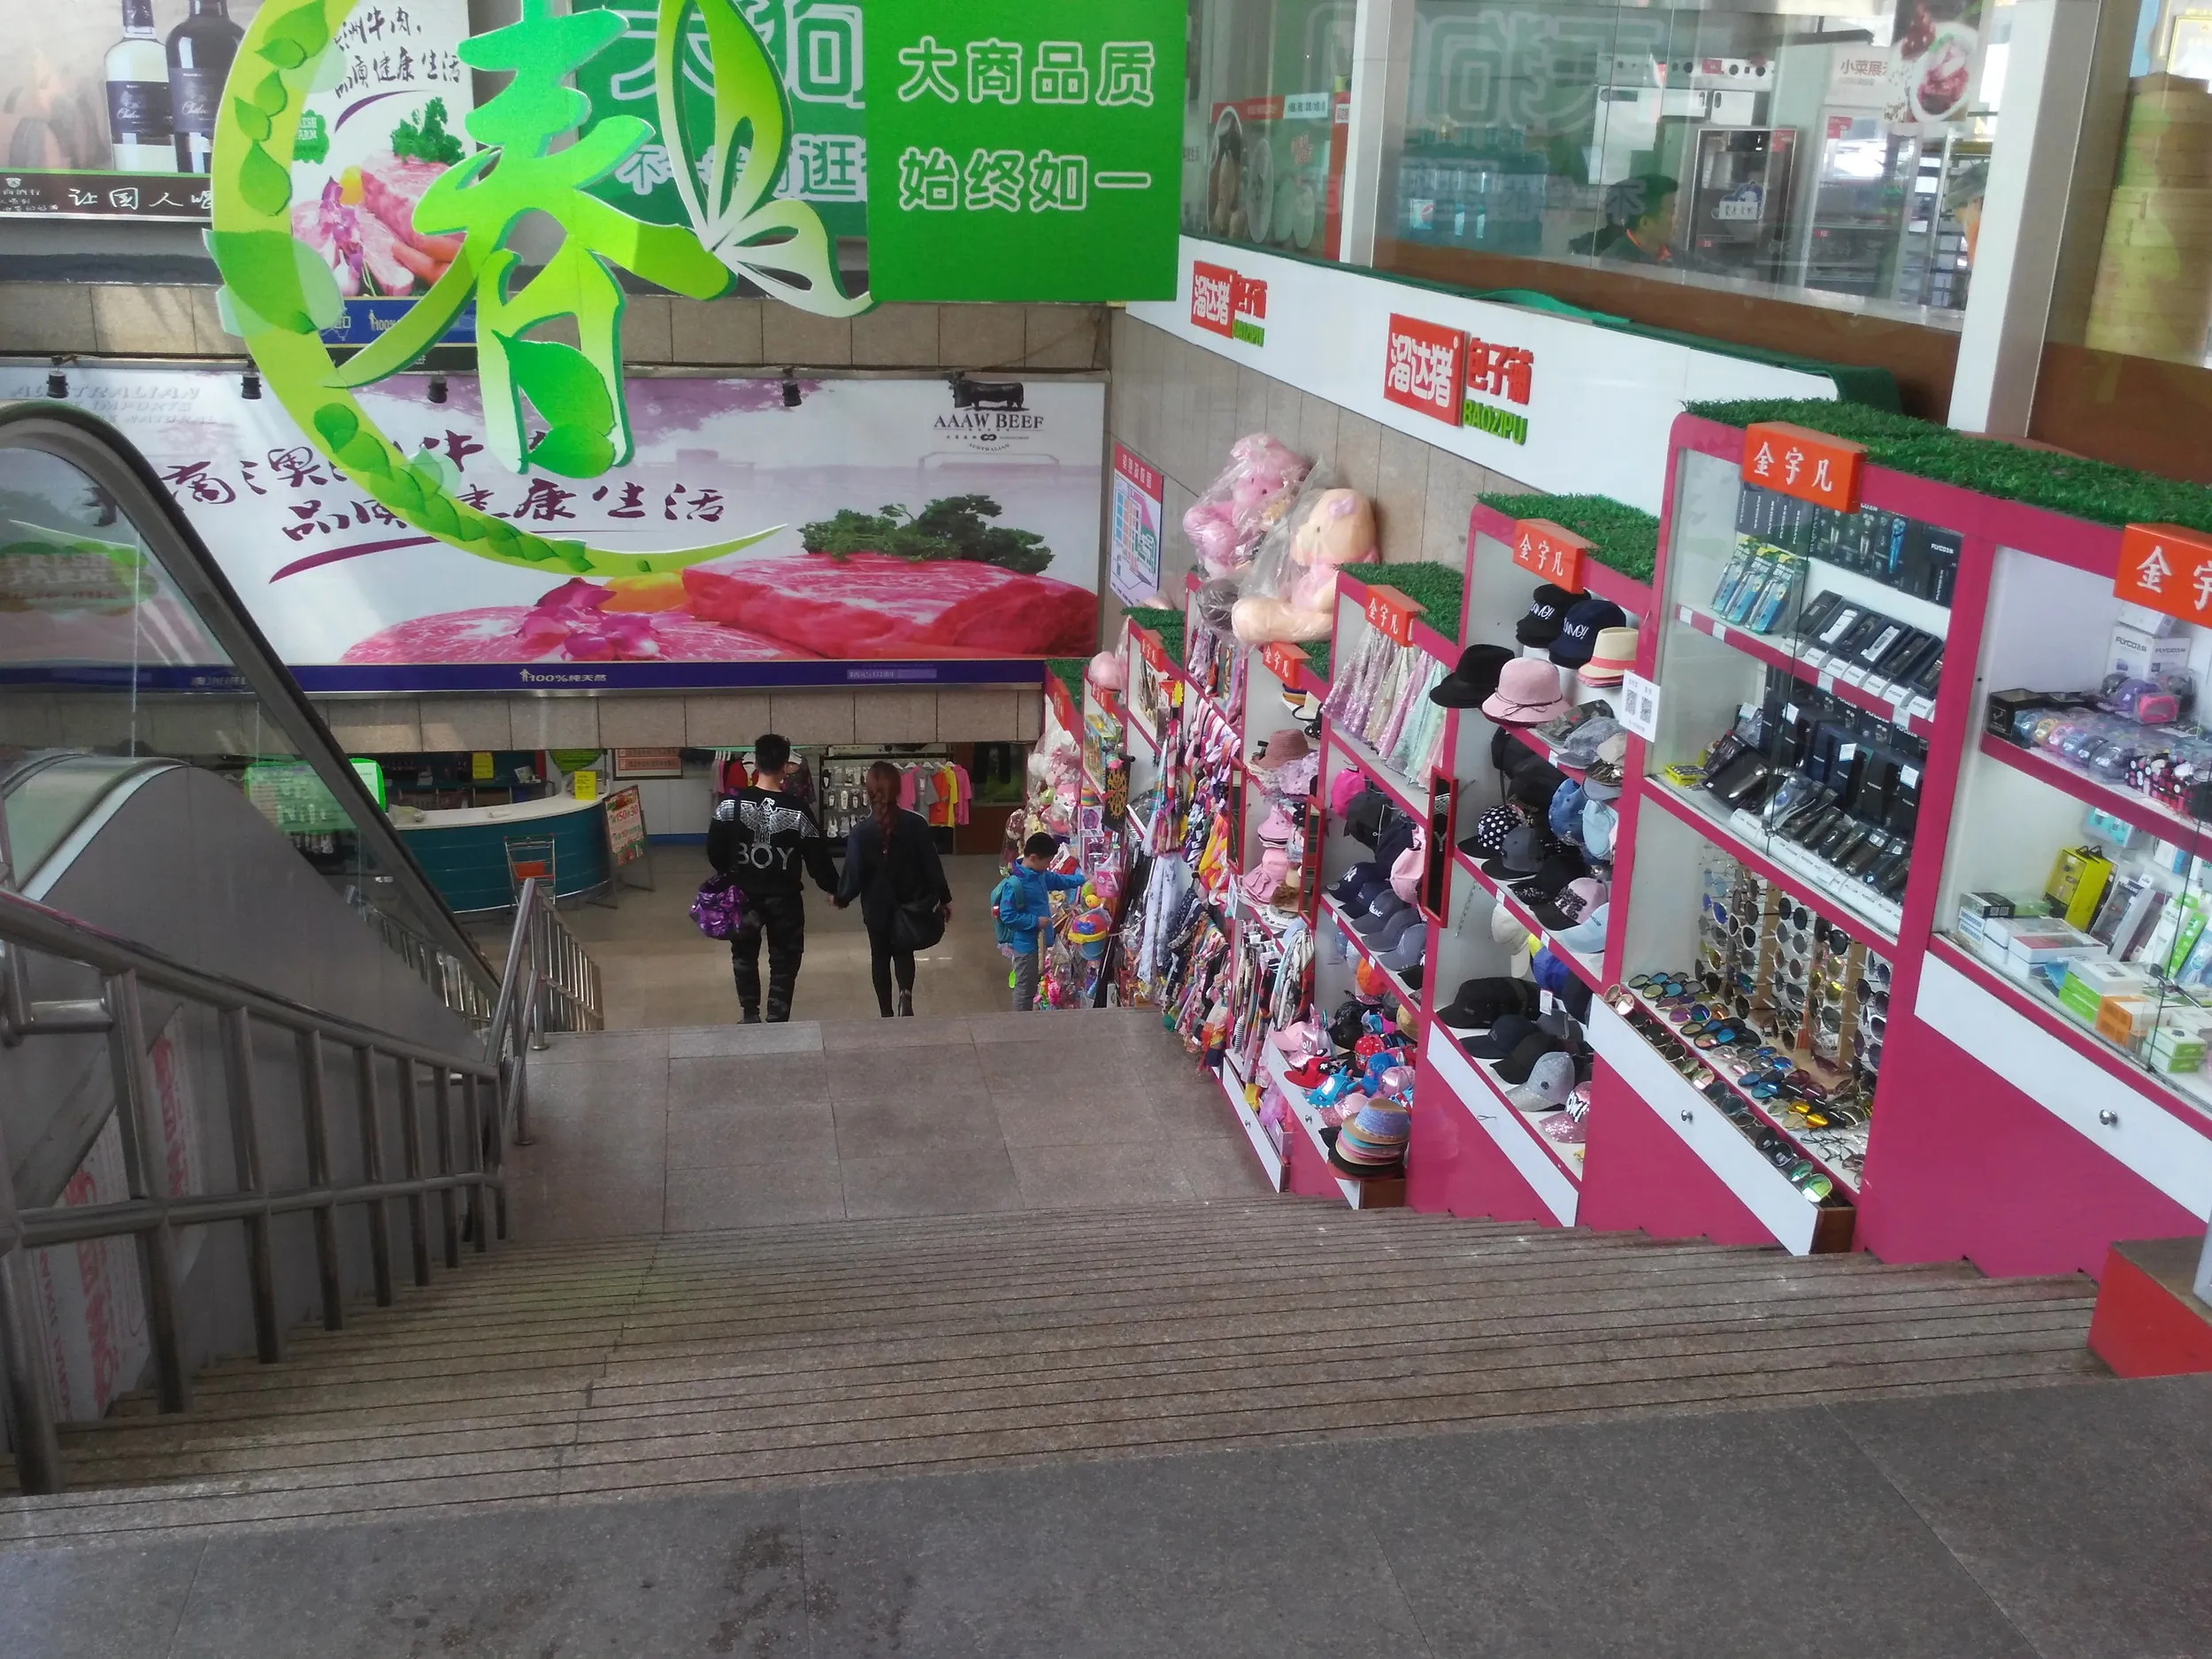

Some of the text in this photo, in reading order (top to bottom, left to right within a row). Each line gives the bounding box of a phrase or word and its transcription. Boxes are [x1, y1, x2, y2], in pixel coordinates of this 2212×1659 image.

[899, 36, 1156, 106] 大商品质
[899, 147, 1152, 211] 始终如一
[11, 384, 201, 399] AUTRALIAN
[1388, 332, 1454, 408] 溜达猪
[934, 413, 1044, 429] AAAW BEEF
[1463, 399, 1529, 445] BAOZIPU
[737, 841, 795, 870] BOY
